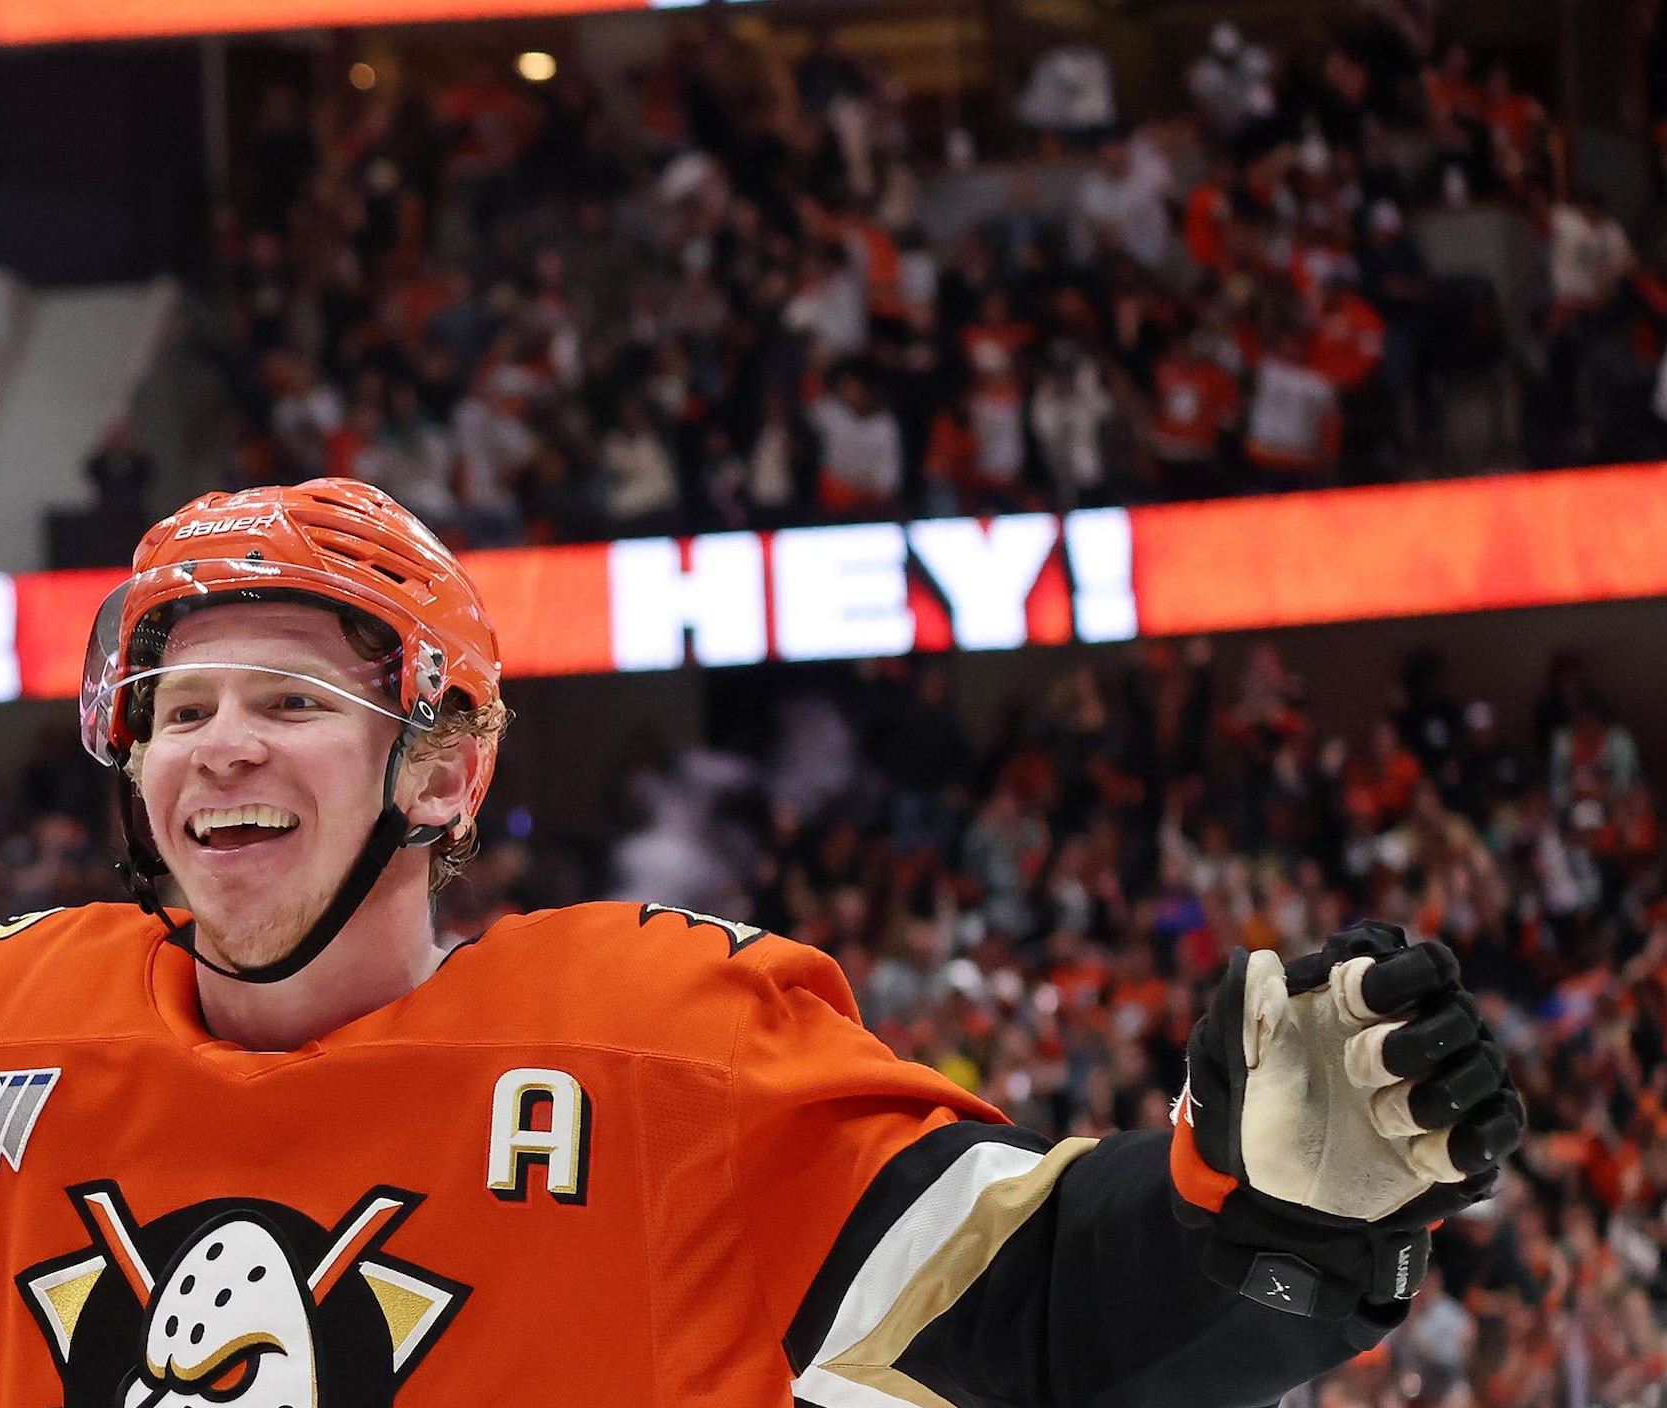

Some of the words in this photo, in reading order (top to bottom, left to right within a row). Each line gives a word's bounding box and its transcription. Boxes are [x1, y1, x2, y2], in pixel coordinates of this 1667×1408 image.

[173, 512, 280, 540] BAUER
[609, 506, 1139, 673] HEY!
[487, 1067, 590, 1205] A
